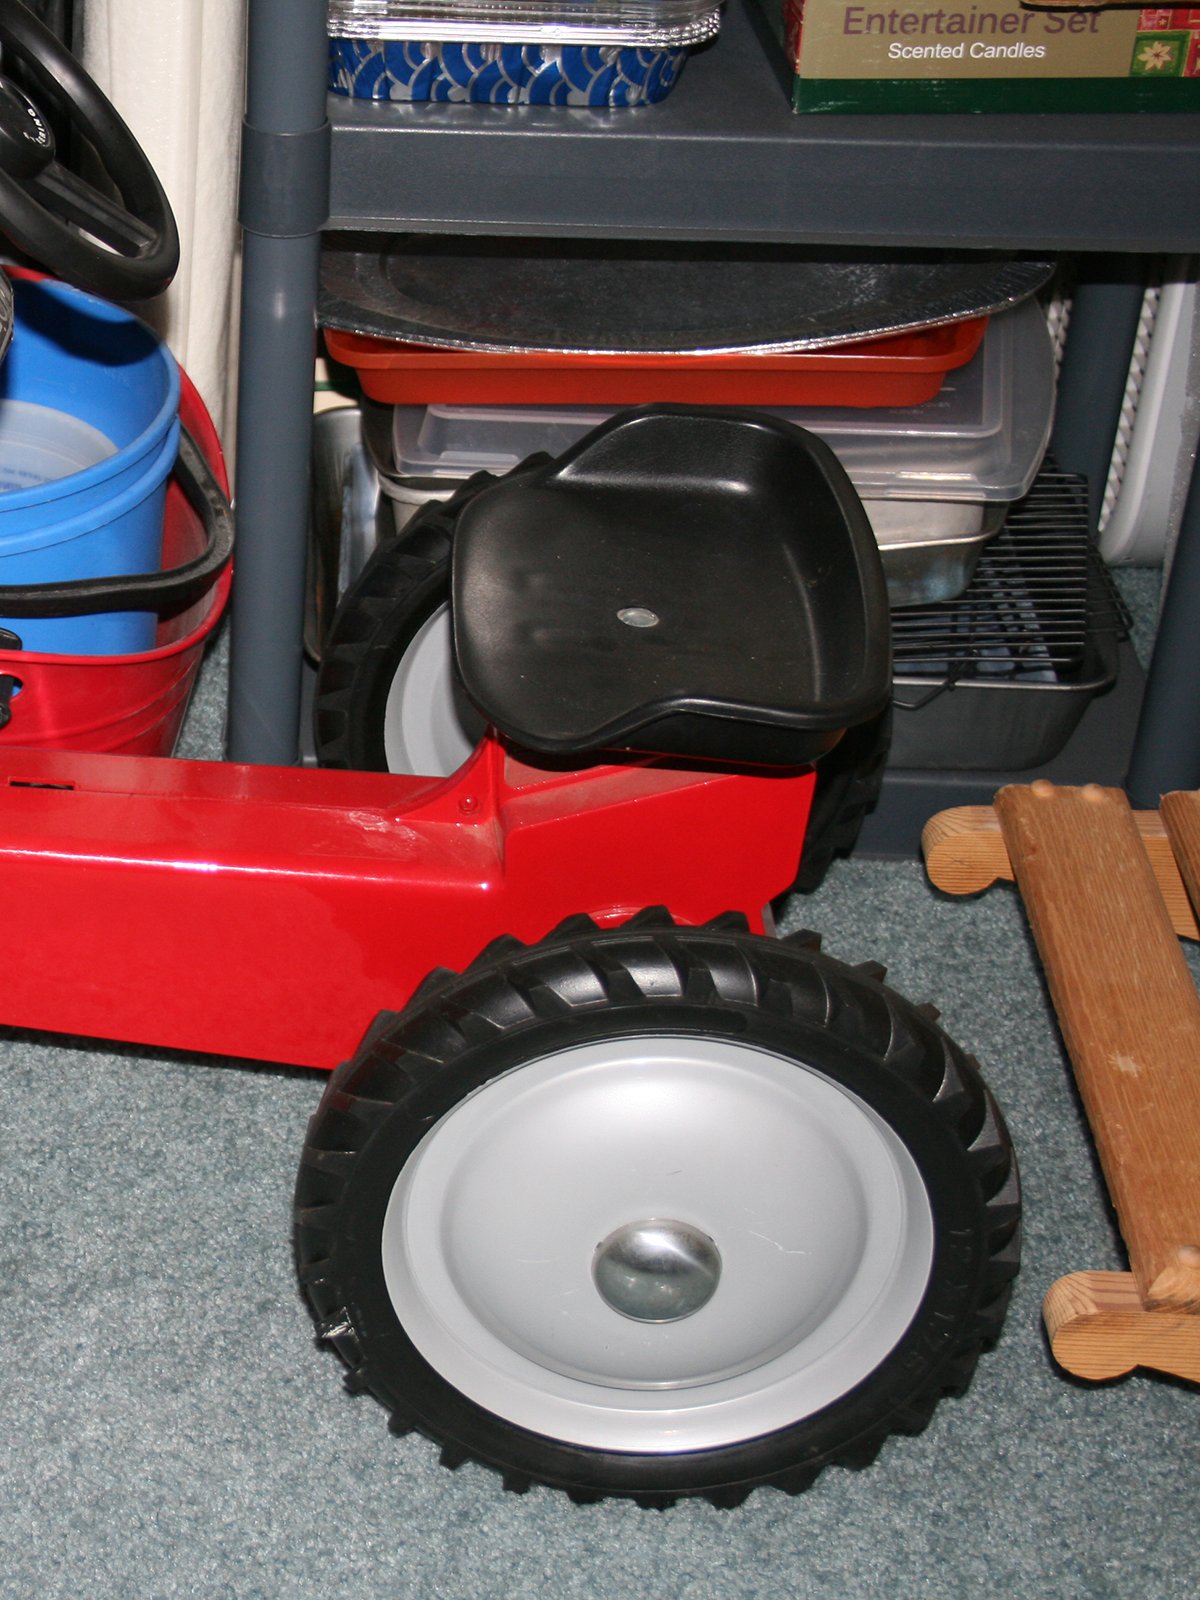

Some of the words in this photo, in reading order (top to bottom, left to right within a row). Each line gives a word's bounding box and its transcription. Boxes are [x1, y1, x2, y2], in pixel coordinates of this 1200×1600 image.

[843, 6, 1034, 35] Entertainer
[1043, 9, 1101, 34] Set
[888, 42, 964, 59] Scented
[969, 42, 1046, 59] Candles
